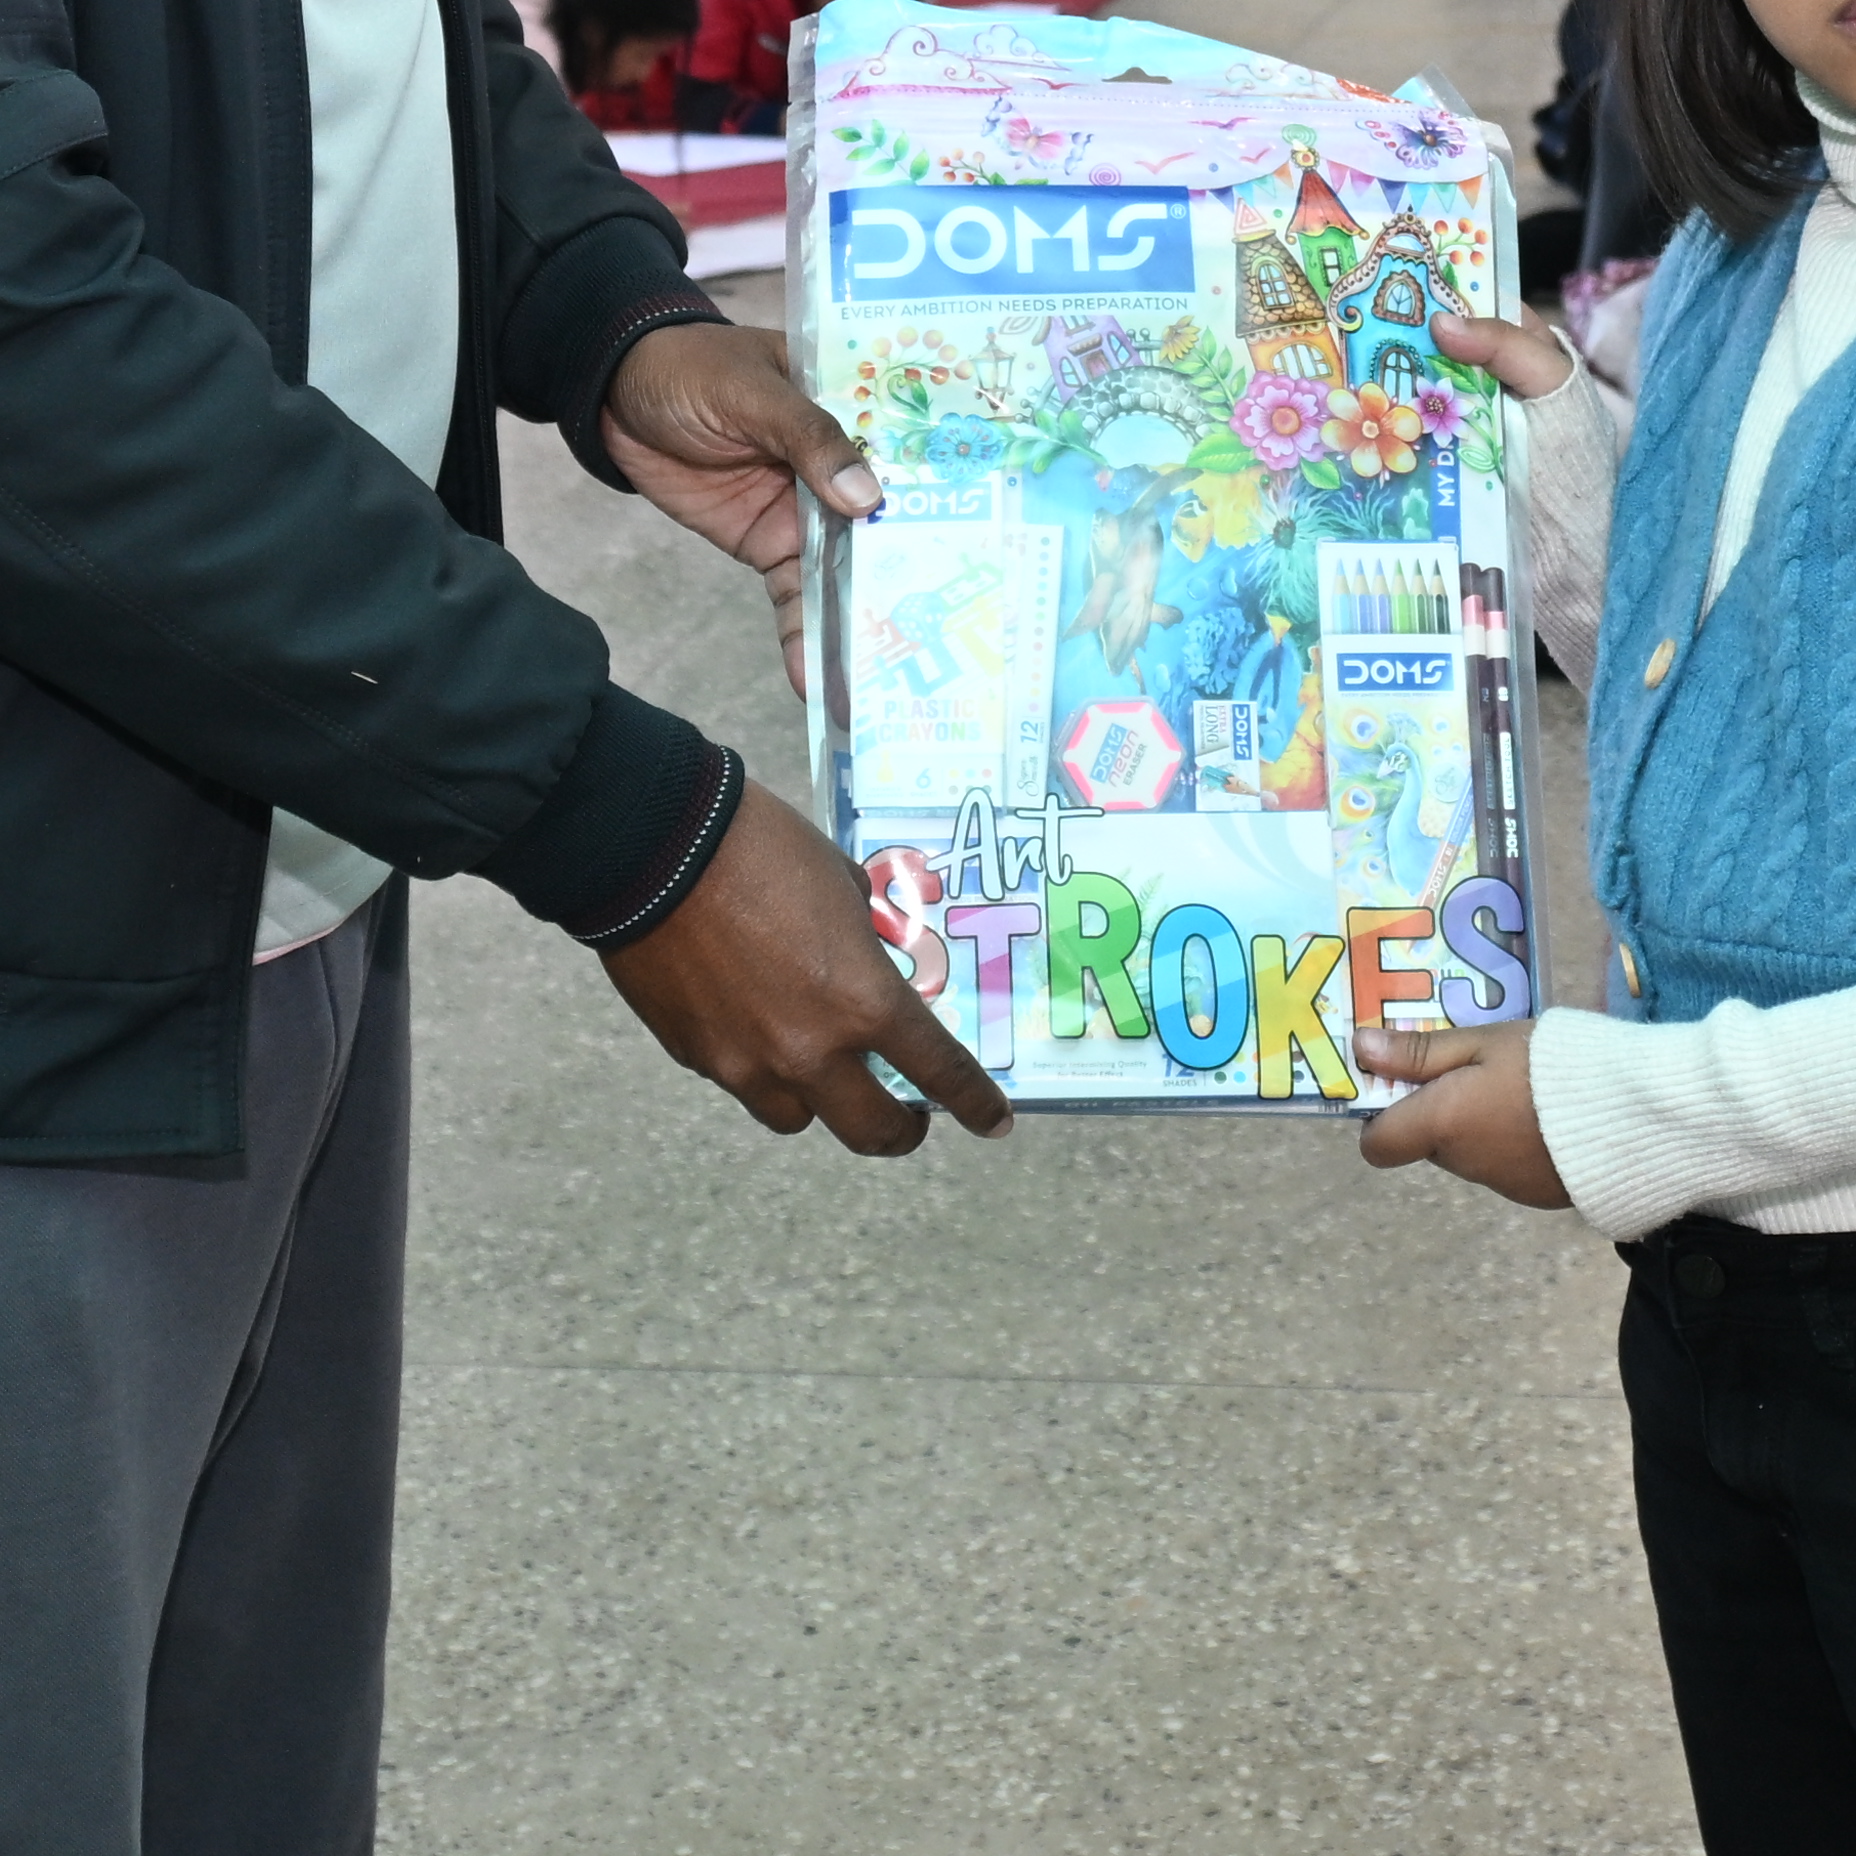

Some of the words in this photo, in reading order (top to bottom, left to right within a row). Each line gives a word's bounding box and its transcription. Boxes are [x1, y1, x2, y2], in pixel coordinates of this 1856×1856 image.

[851, 203, 1169, 279] DOMS
[840, 305, 896, 321] EVERY
[900, 299, 993, 317] AMBITION
[997, 299, 1057, 312] NEEDS
[1062, 297, 1189, 312] PREPARATION
[875, 488, 985, 517] DOMS
[1437, 472, 1455, 506] MY
[1343, 659, 1446, 685] DOMS
[883, 699, 976, 720] PLASTIC
[1205, 706, 1220, 744] LONG
[879, 721, 982, 743] CRAYONS
[1020, 720, 1039, 744] 12
[1234, 706, 1250, 758] DOMS
[1092, 726, 1123, 782] DOMS
[1107, 729, 1140, 788] neon
[1122, 743, 1149, 786] ERASER
[915, 768, 932, 789] 6
[925, 787, 1105, 904] Art
[1504, 816, 1519, 859] DOMS
[1429, 862, 1447, 898] DOMS
[860, 845, 1533, 1101] STROKES
[1162, 1079, 1198, 1087] SHADES
